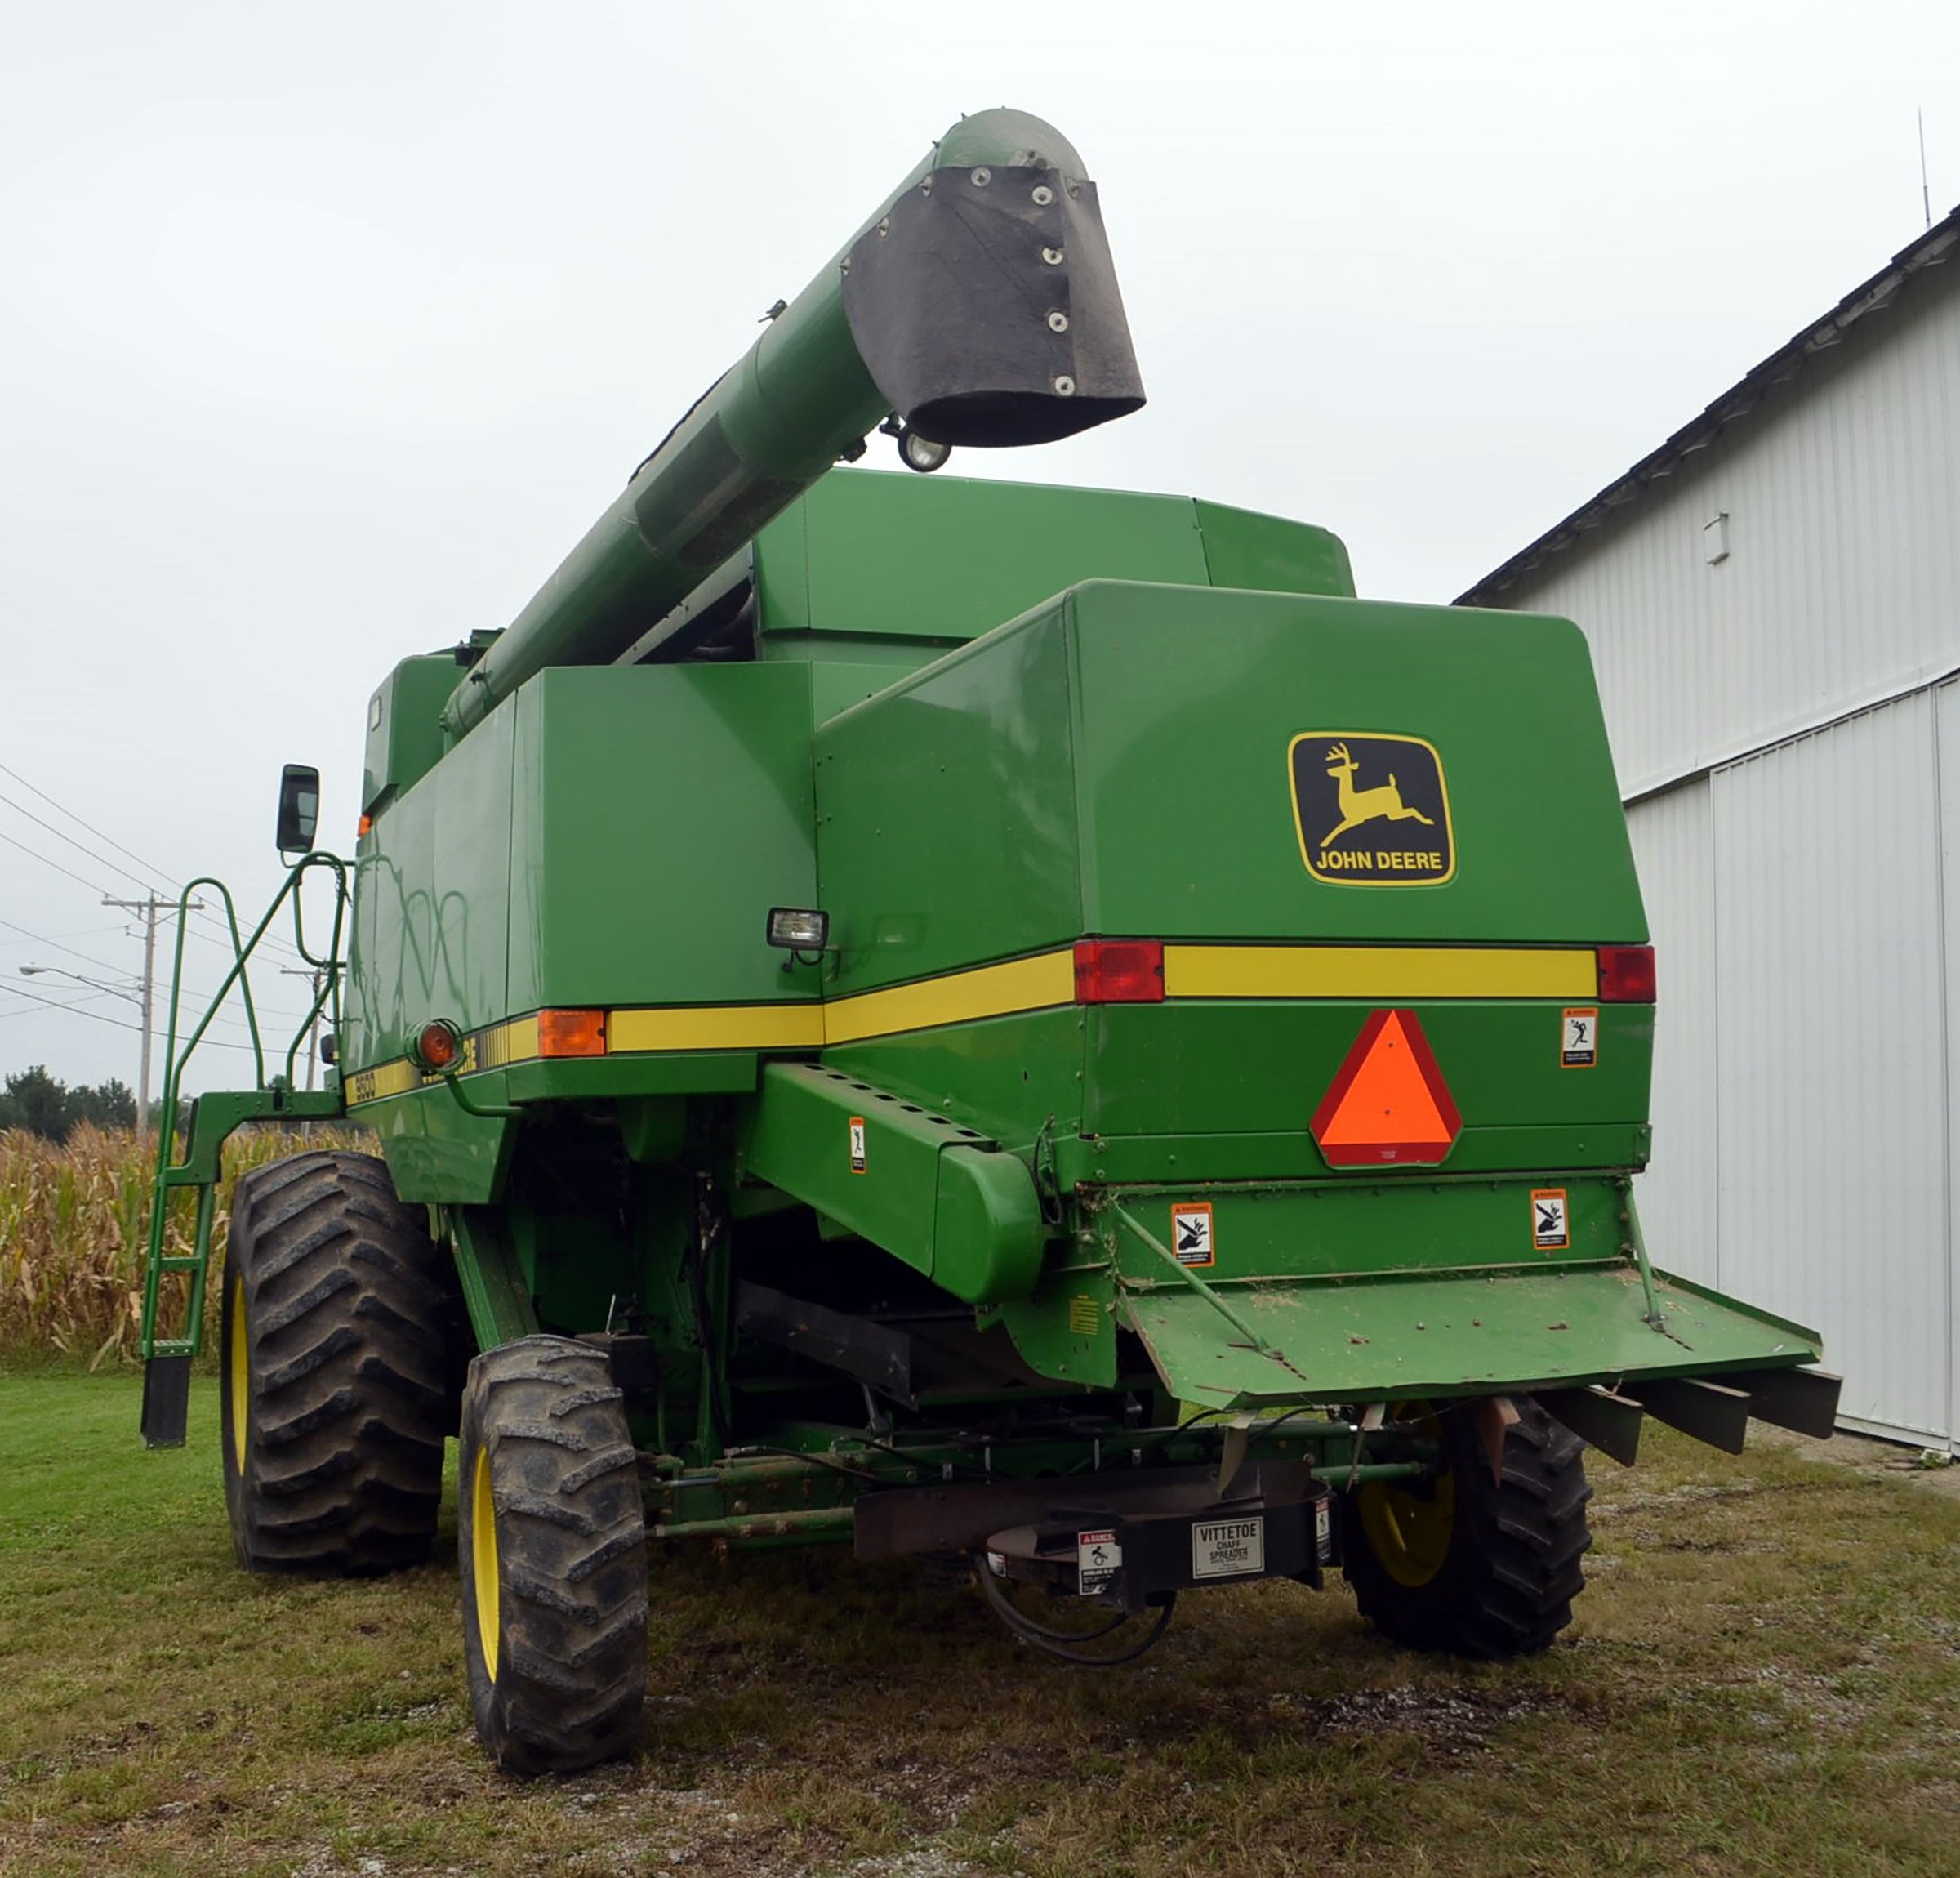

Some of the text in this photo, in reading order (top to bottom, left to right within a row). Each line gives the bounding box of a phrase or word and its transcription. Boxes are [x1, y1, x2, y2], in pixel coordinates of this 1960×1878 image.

[1316, 851, 1443, 869] JOHN DEERE
[1200, 1523, 1257, 1541] VITTETOE
